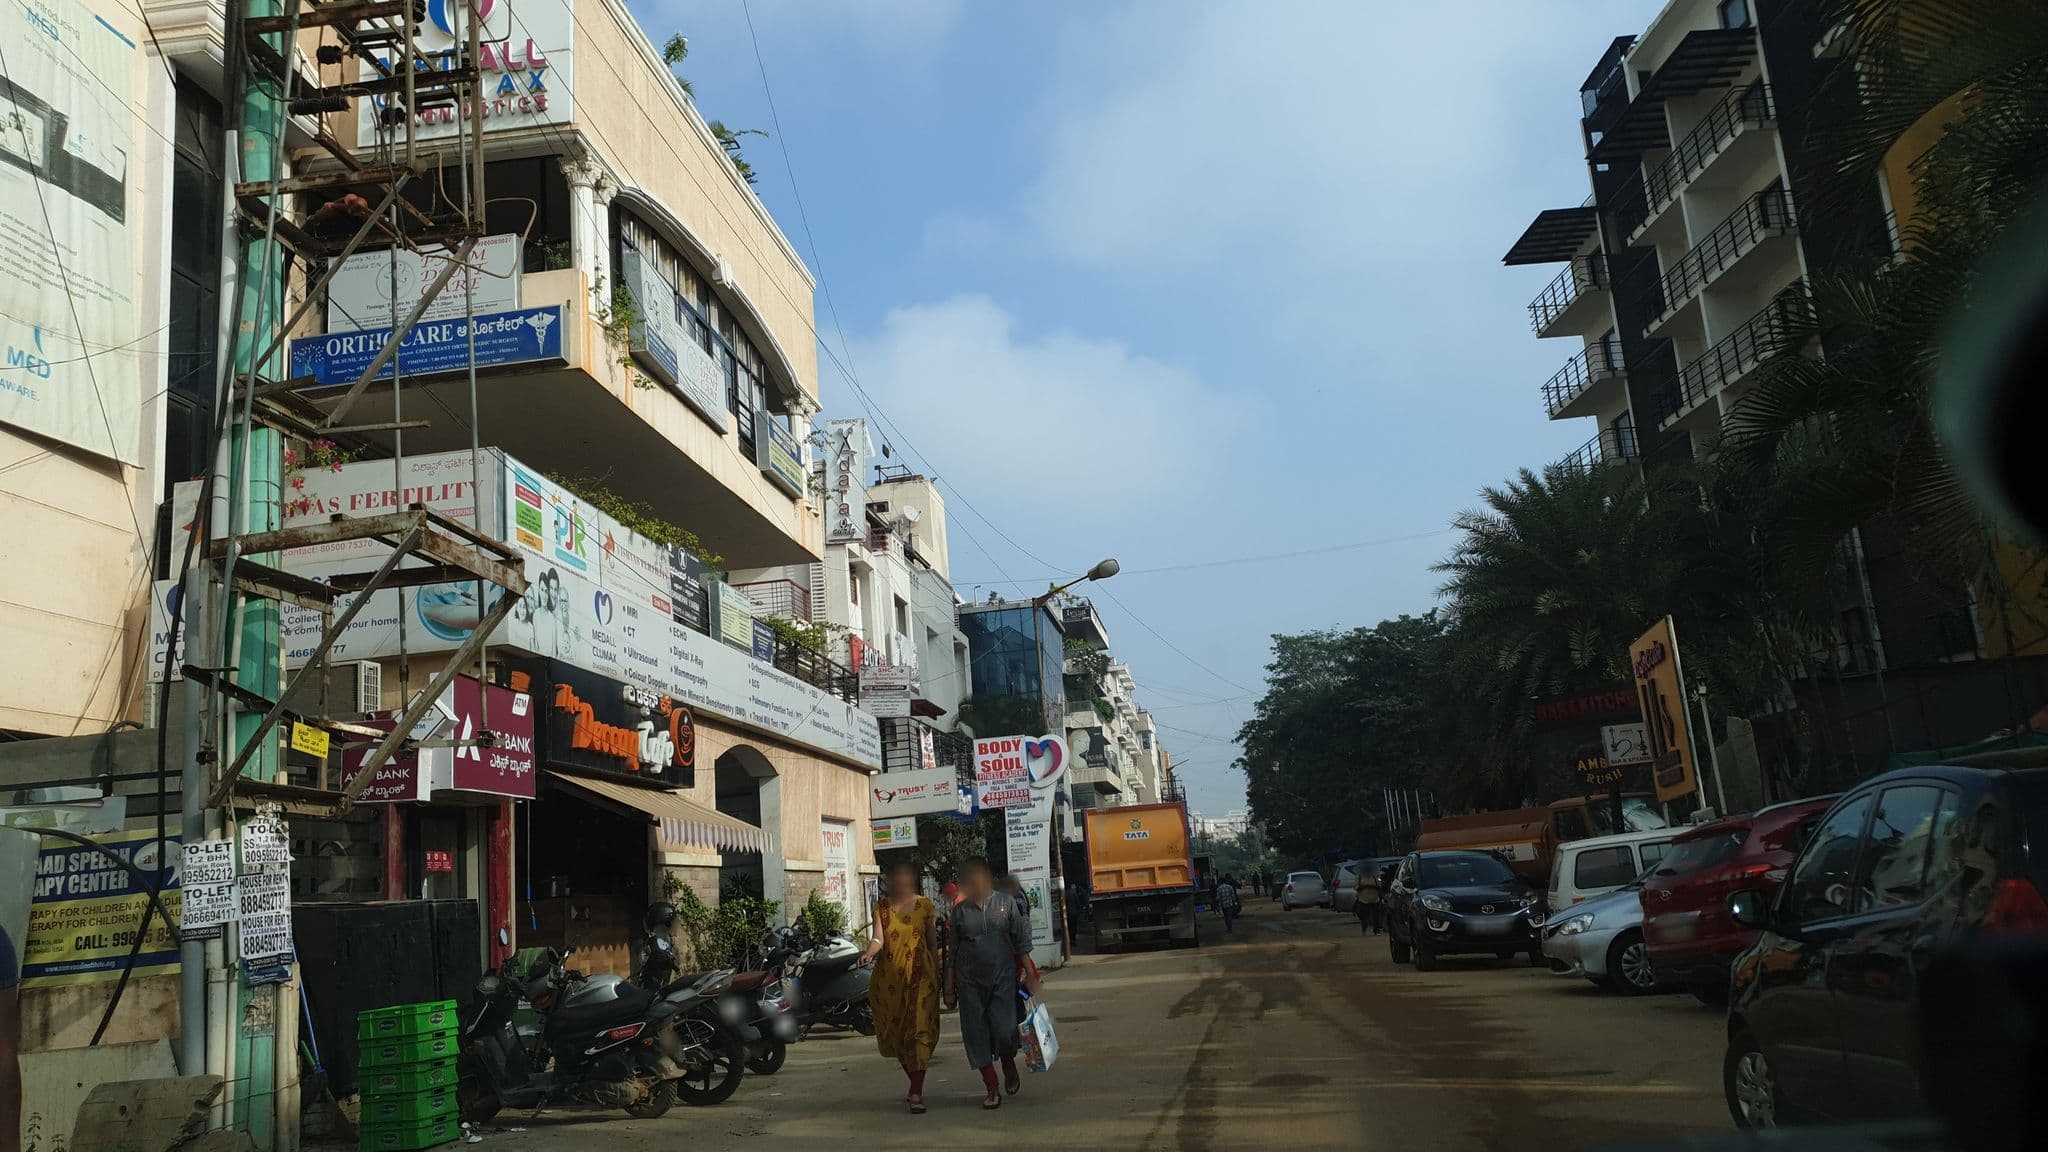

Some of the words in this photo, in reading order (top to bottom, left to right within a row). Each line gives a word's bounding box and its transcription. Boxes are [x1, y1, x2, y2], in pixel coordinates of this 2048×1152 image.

[350, 480, 485, 511] FERTILITY
[555, 505, 588, 560] PJR
[592, 628, 617, 648] MEDALL
[627, 626, 636, 639] CT
[627, 646, 659, 668] Ultrasound
[673, 645, 690, 661] Digital
[628, 667, 647, 684] Colour
[648, 674, 668, 690] Doppler
[515, 697, 527, 708] ATM
[505, 733, 532, 754] BANK
[977, 740, 1021, 756] BODY
[980, 757, 1024, 773] SOUL
[376, 768, 411, 780] BANK
[897, 785, 925, 797] TRUST
[822, 830, 844, 853] TRUST
[1125, 831, 1149, 839] TATA
[182, 842, 232, 855] TO-LET
[206, 853, 231, 862] BHK
[210, 860, 231, 868] Room
[68, 869, 130, 895] CENTER
[240, 875, 261, 890] HOUSE
[184, 884, 235, 900] TO-LET
[206, 895, 233, 905] BHK
[60, 906, 81, 918] FOR
[82, 900, 133, 916] CHILDREN
[211, 902, 232, 910] Room
[66, 917, 87, 929] FOR
[88, 912, 139, 927] CHILDREN
[183, 907, 236, 925] 9066694117
[242, 916, 264, 930] HOUSE
[264, 914, 274, 928] FOR
[274, 913, 286, 927] RENT
[75, 934, 109, 951] CALL:
